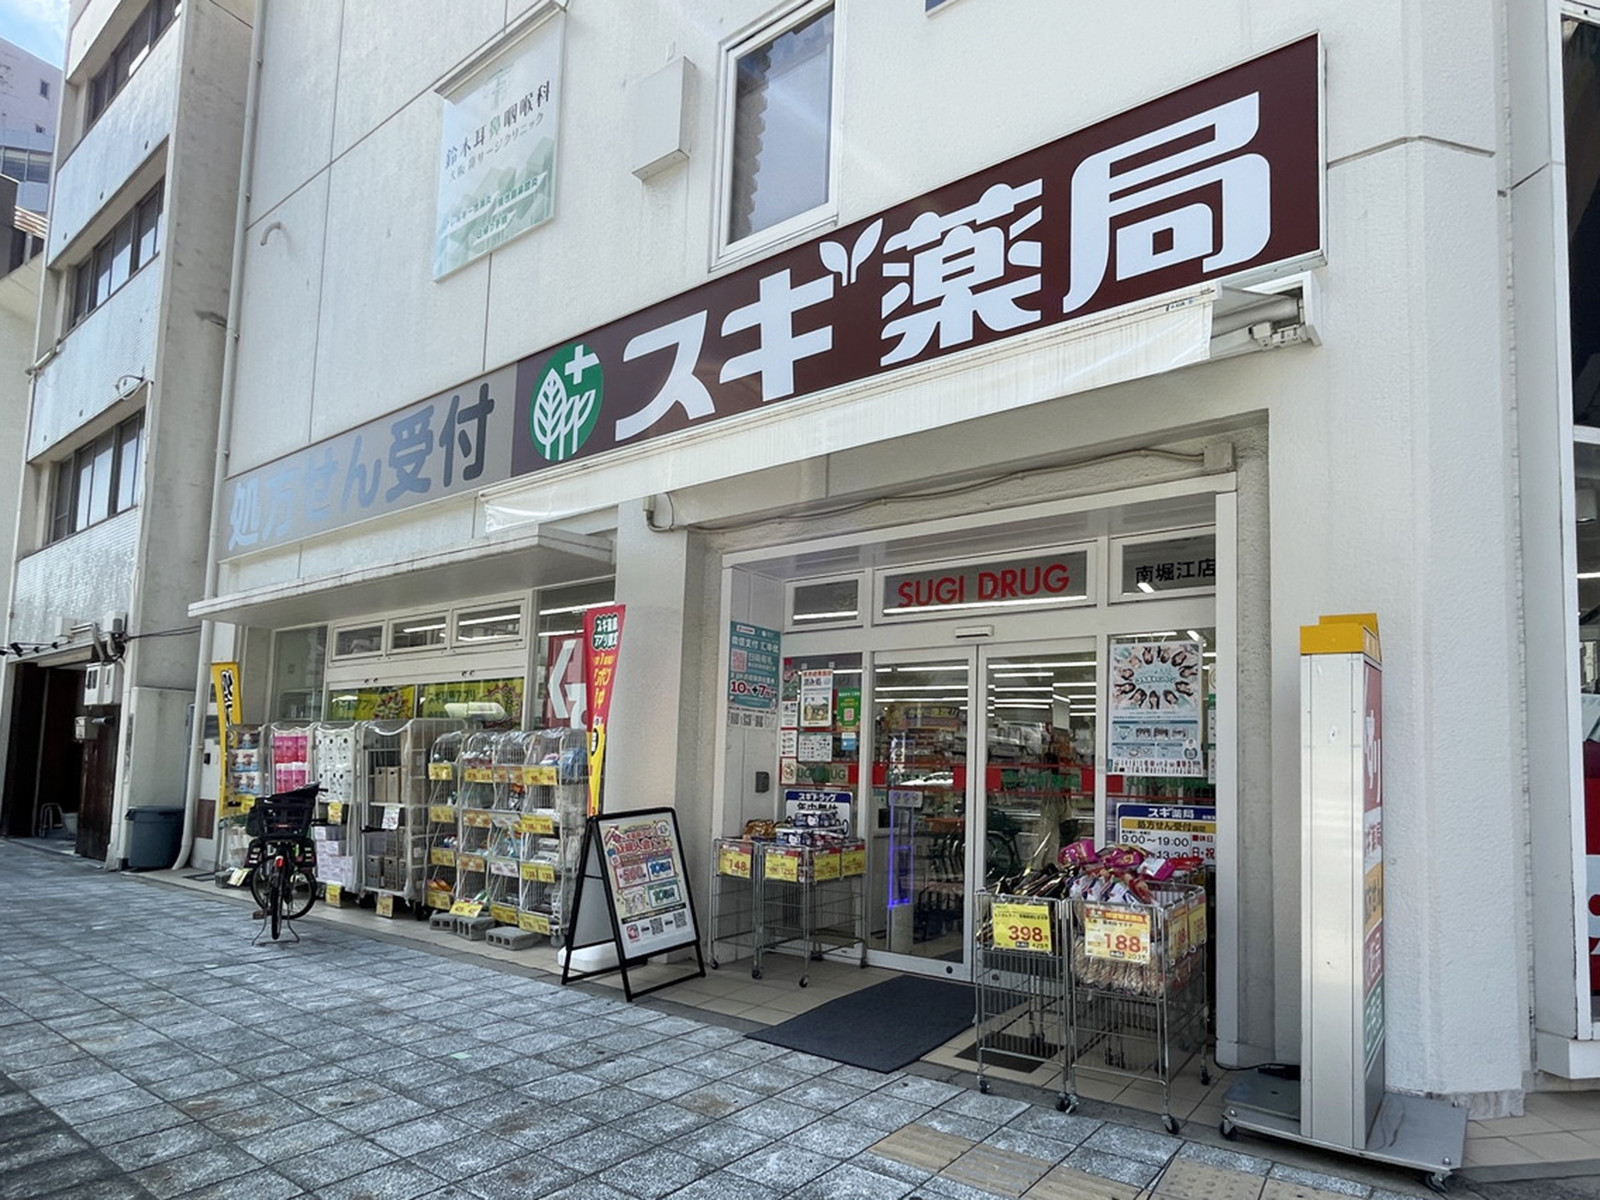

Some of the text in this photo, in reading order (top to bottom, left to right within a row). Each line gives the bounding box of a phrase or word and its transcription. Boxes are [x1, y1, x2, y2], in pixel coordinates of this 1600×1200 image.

[445, 81, 550, 170] 鈴木耳鼻咽喉科
[615, 92, 1271, 442] スギ薬局
[228, 383, 495, 551] 処方せん受付
[898, 563, 1069, 608] SUGI DRUG
[1135, 557, 1216, 584] 南堀江店
[1147, 807, 1195, 819] スギ薬局
